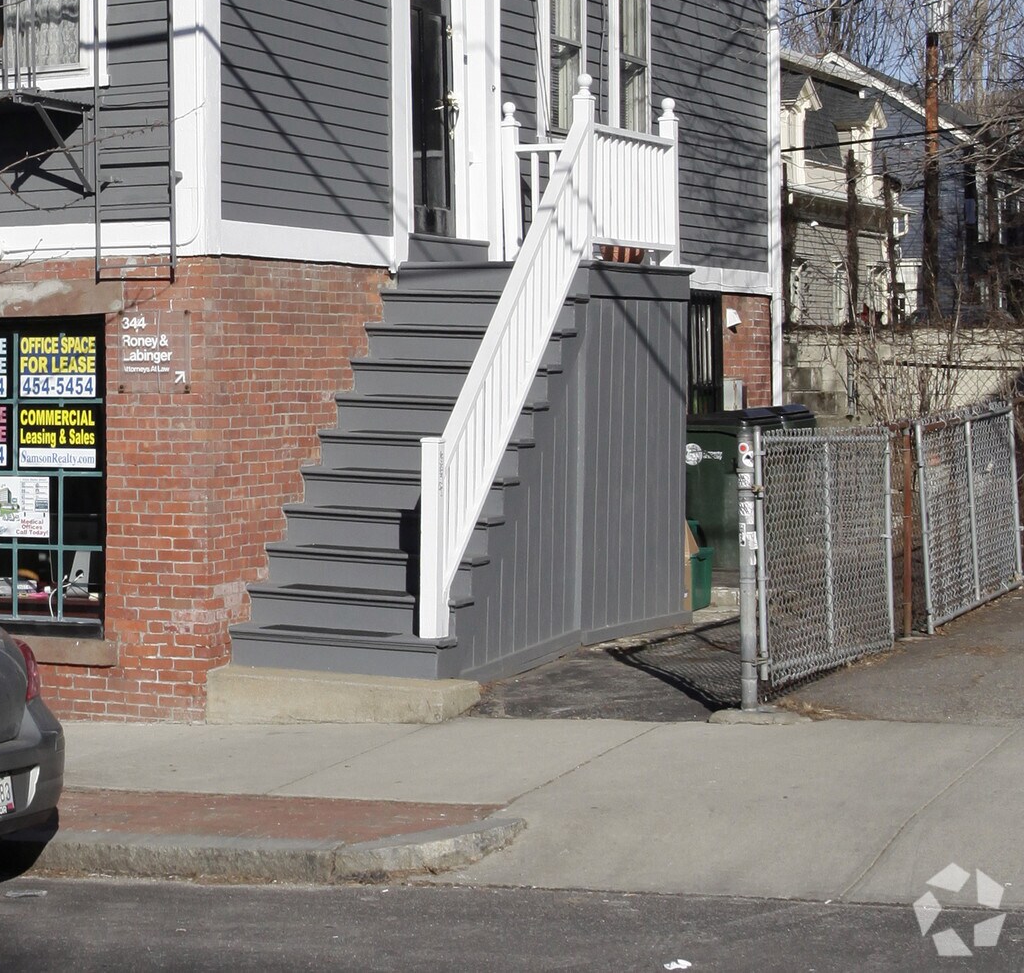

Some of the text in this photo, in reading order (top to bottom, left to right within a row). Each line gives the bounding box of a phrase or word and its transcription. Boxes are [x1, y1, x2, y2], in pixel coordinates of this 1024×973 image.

[122, 317, 146, 329] 344
[20, 337, 95, 354] OFFICE SPACE
[123, 334, 168, 348] Roney &
[20, 357, 95, 373] FOR LEASE
[23, 377, 93, 395] 454-5454
[20, 410, 95, 425] COMMERCIAL
[20, 429, 95, 448] Leasing & Sales
[21, 451, 94, 466] SamsonRealty.com
